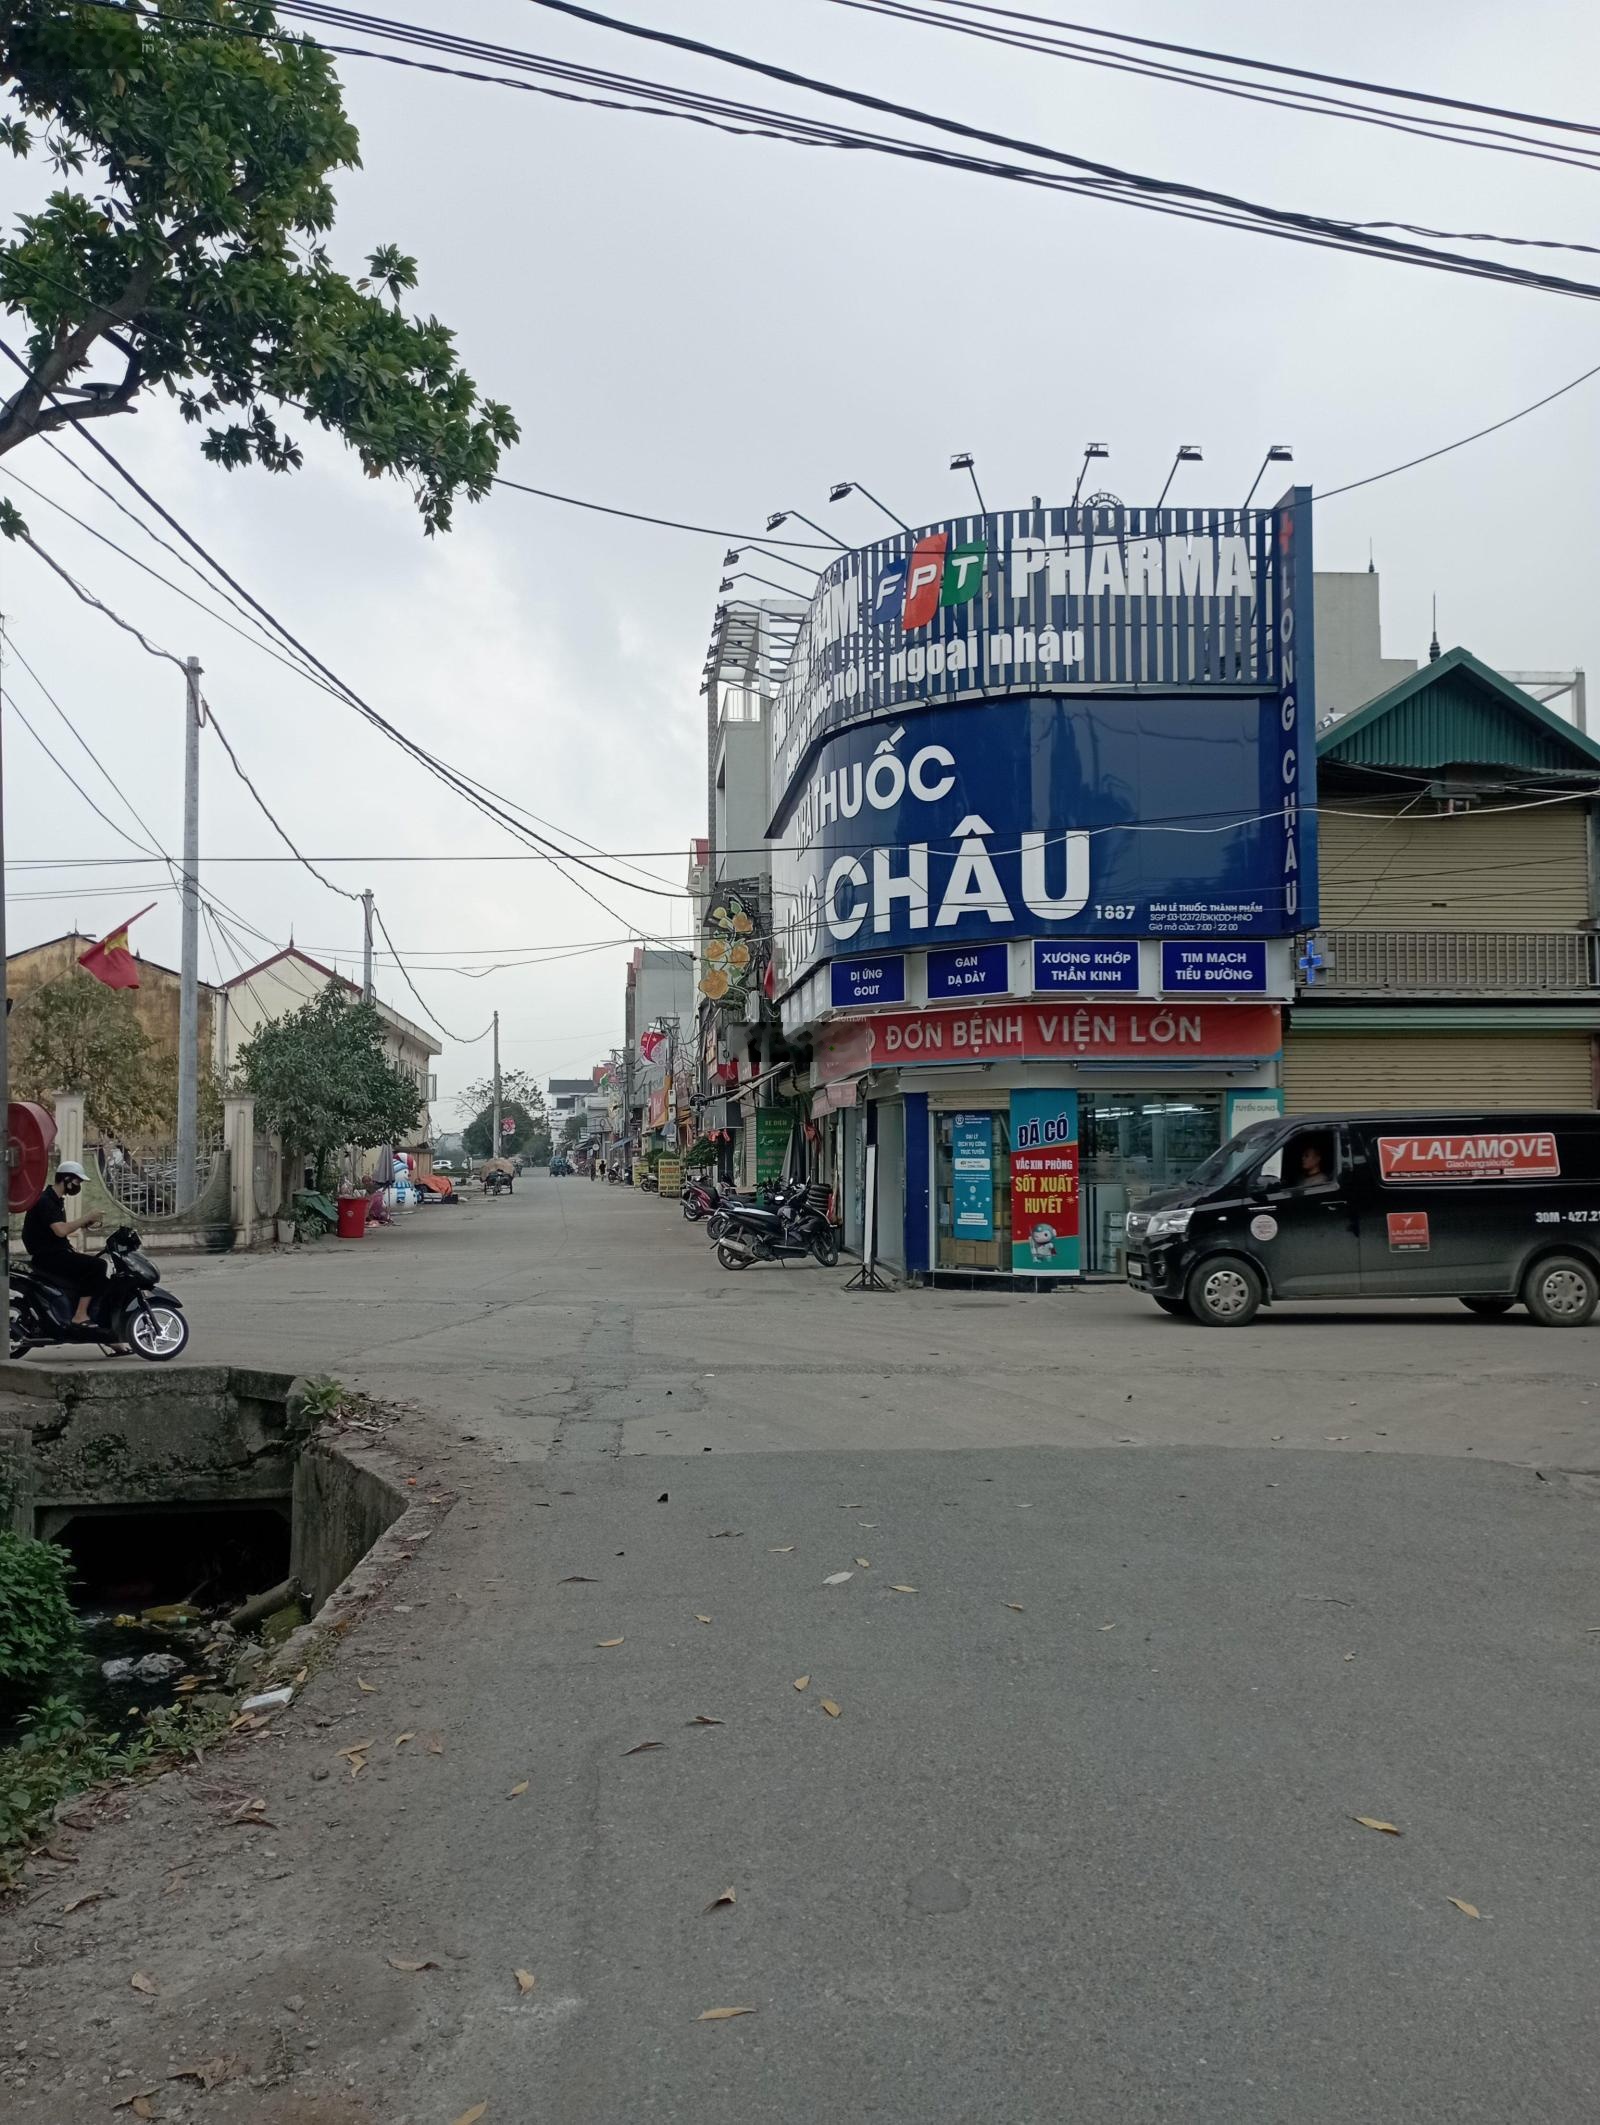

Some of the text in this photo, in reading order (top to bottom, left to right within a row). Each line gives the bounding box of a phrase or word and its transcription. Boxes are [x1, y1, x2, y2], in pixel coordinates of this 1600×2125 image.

[876, 556, 979, 610] FPT
[1011, 535, 1254, 598] PHARMA
[890, 630, 978, 684] ngoại
[991, 624, 1085, 671] nhập
[1280, 566, 1297, 916] LONG CHÂU
[813, 726, 956, 832] THUỐC
[825, 814, 1090, 940] CHÂU
[1179, 902, 1208, 911] THUỐC
[1210, 902, 1237, 912] THÀNH
[1218, 923, 1238, 931] 2200
[955, 956, 978, 968] GAN
[1042, 951, 1131, 964] XƯƠNG KHỚP
[1181, 953, 1247, 965] TIM MẠCH
[851, 968, 883, 982] DỊ ỨNG
[948, 971, 986, 986] DẠ DÀY
[1051, 966, 1122, 981] THẦN KINH
[1176, 965, 1253, 980] TIỂU ĐƯỜNG
[854, 985, 880, 996] GOUT
[886, 1020, 942, 1050] ĐƠN
[953, 1012, 1023, 1053] BỆNH
[1038, 1009, 1116, 1050] VIỆN
[1131, 1009, 1201, 1042] LỚN
[1018, 1112, 1068, 1148] ĐÃ CÓ
[1411, 1138, 1552, 1160] LALAMOVE
[1030, 1160, 1043, 1170] XIN
[1045, 1158, 1073, 1170] PHÒNG
[1015, 1173, 1073, 1193] SỐT XUẤT
[1024, 1194, 1063, 1214] HUYẾT
[1568, 1210, 1600, 1223] 427.2
